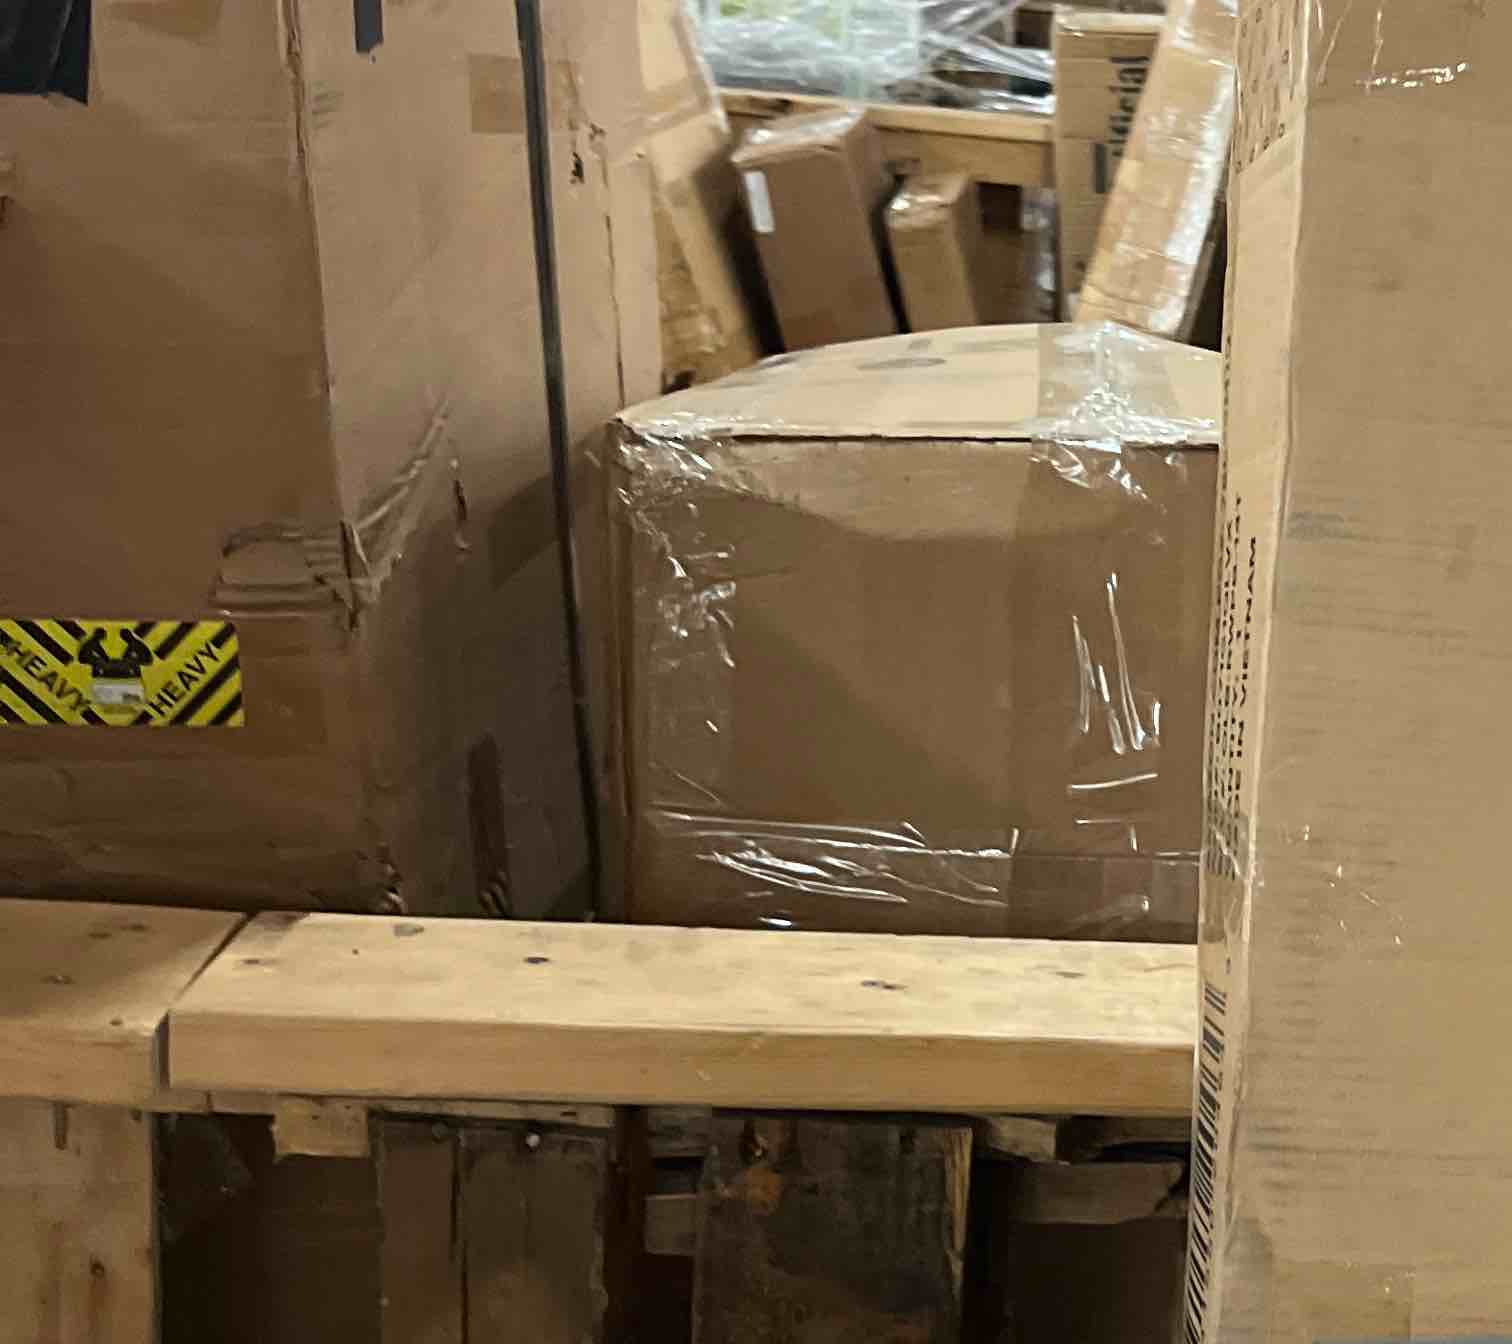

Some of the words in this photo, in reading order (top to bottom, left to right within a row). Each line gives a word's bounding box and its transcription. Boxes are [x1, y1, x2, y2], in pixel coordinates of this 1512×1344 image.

[1239, 536, 1256, 707] VIETNAM
[149, 639, 220, 719] HEAVY
[1236, 719, 1245, 758] IN
